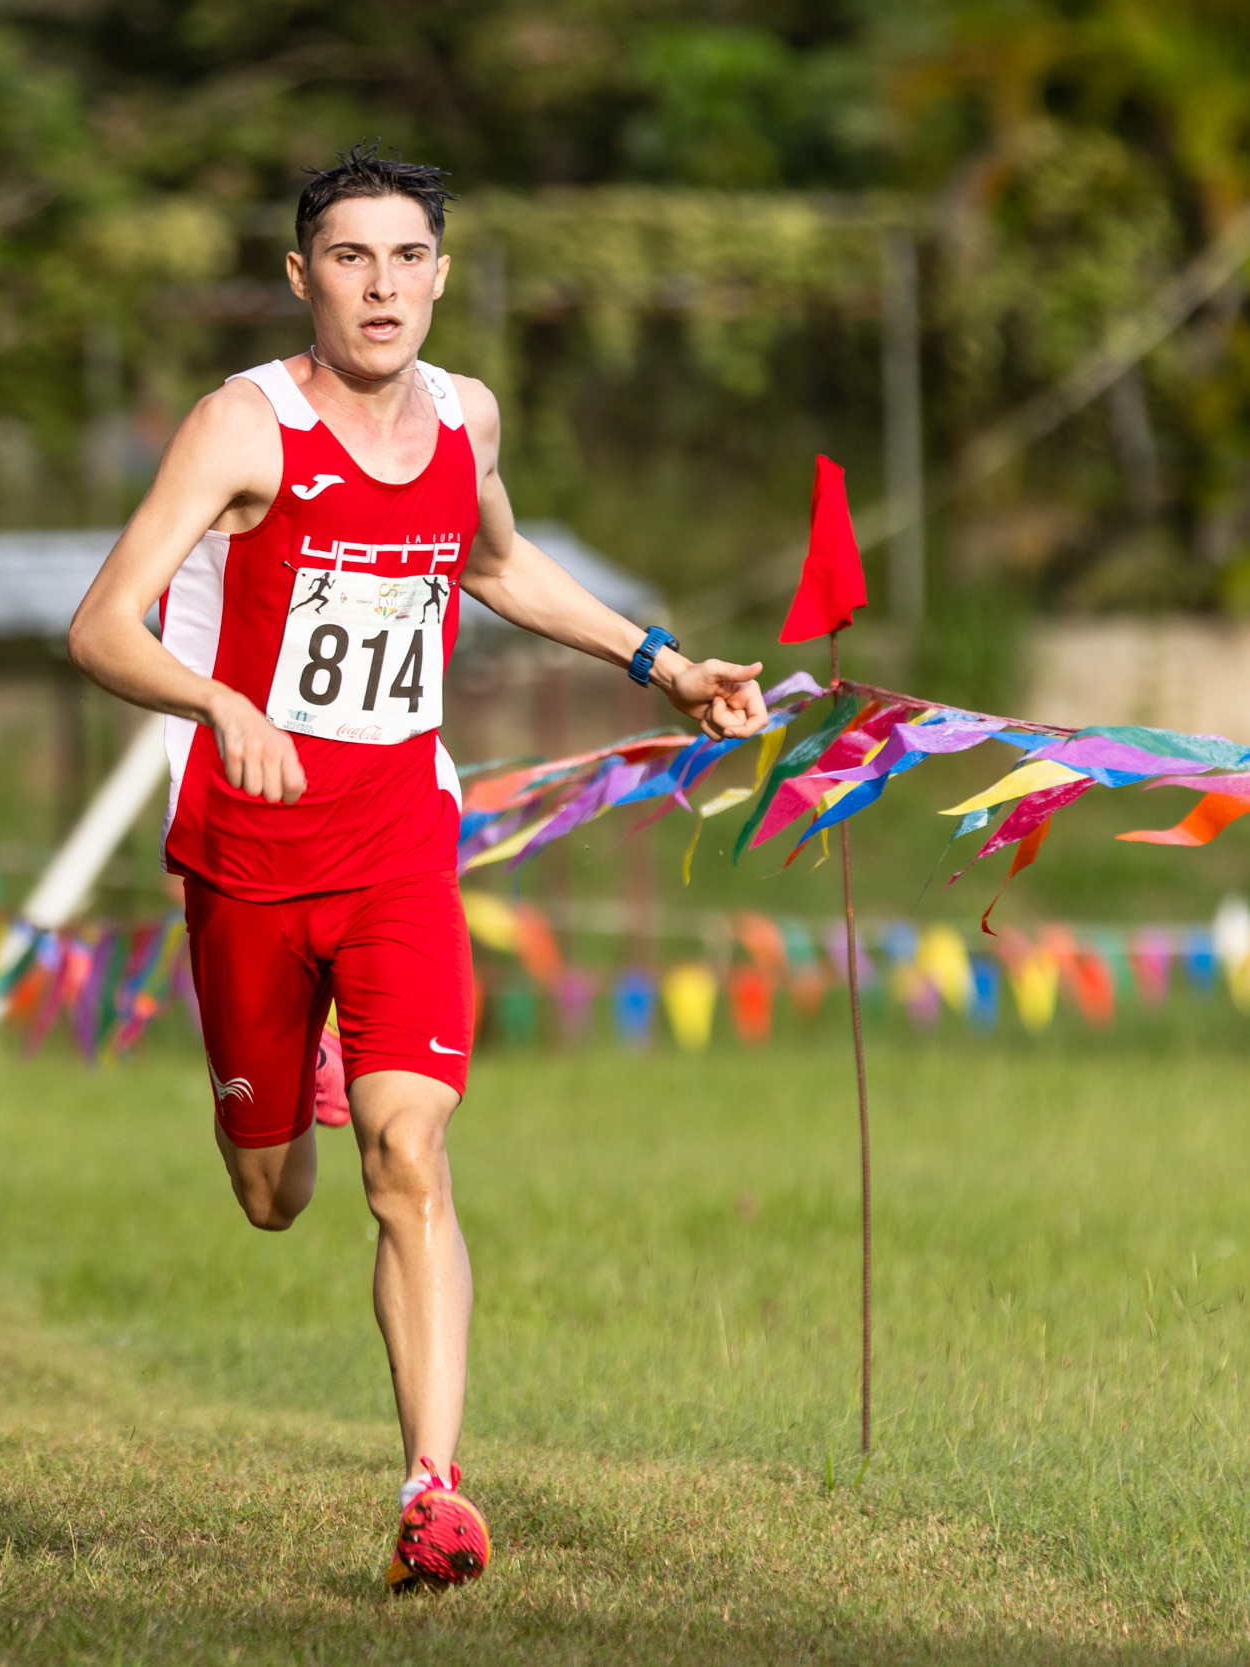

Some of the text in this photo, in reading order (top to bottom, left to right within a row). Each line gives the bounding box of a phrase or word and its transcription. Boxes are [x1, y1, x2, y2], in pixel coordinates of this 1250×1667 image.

[406, 533, 461, 544] LA IUPI
[299, 624, 424, 713] 814
[286, 720, 313, 730] SEGUROS
